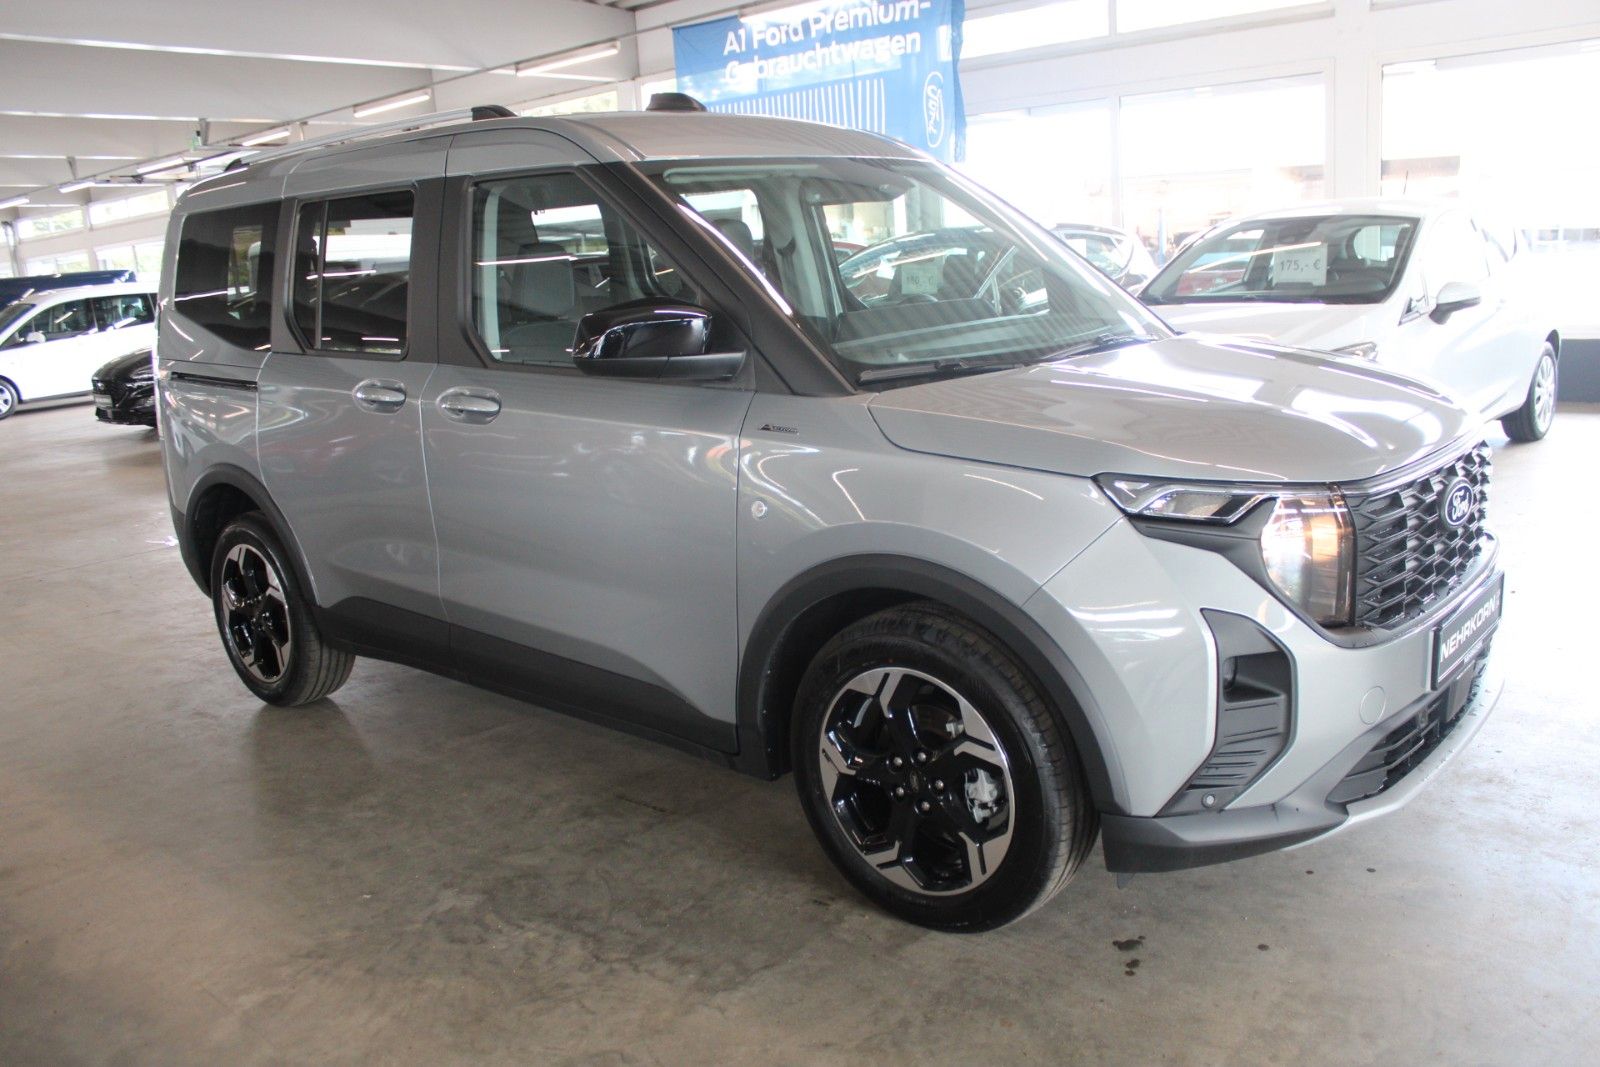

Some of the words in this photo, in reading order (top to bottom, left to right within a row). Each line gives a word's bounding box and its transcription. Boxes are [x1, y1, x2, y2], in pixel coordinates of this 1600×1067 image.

[723, 28, 746, 56] A1
[751, 21, 804, 48] Ford
[724, 31, 921, 84] Gbrauchtwagen
[1313, 259, 1321, 270] €
[1440, 594, 1496, 662] NEHRKORN
